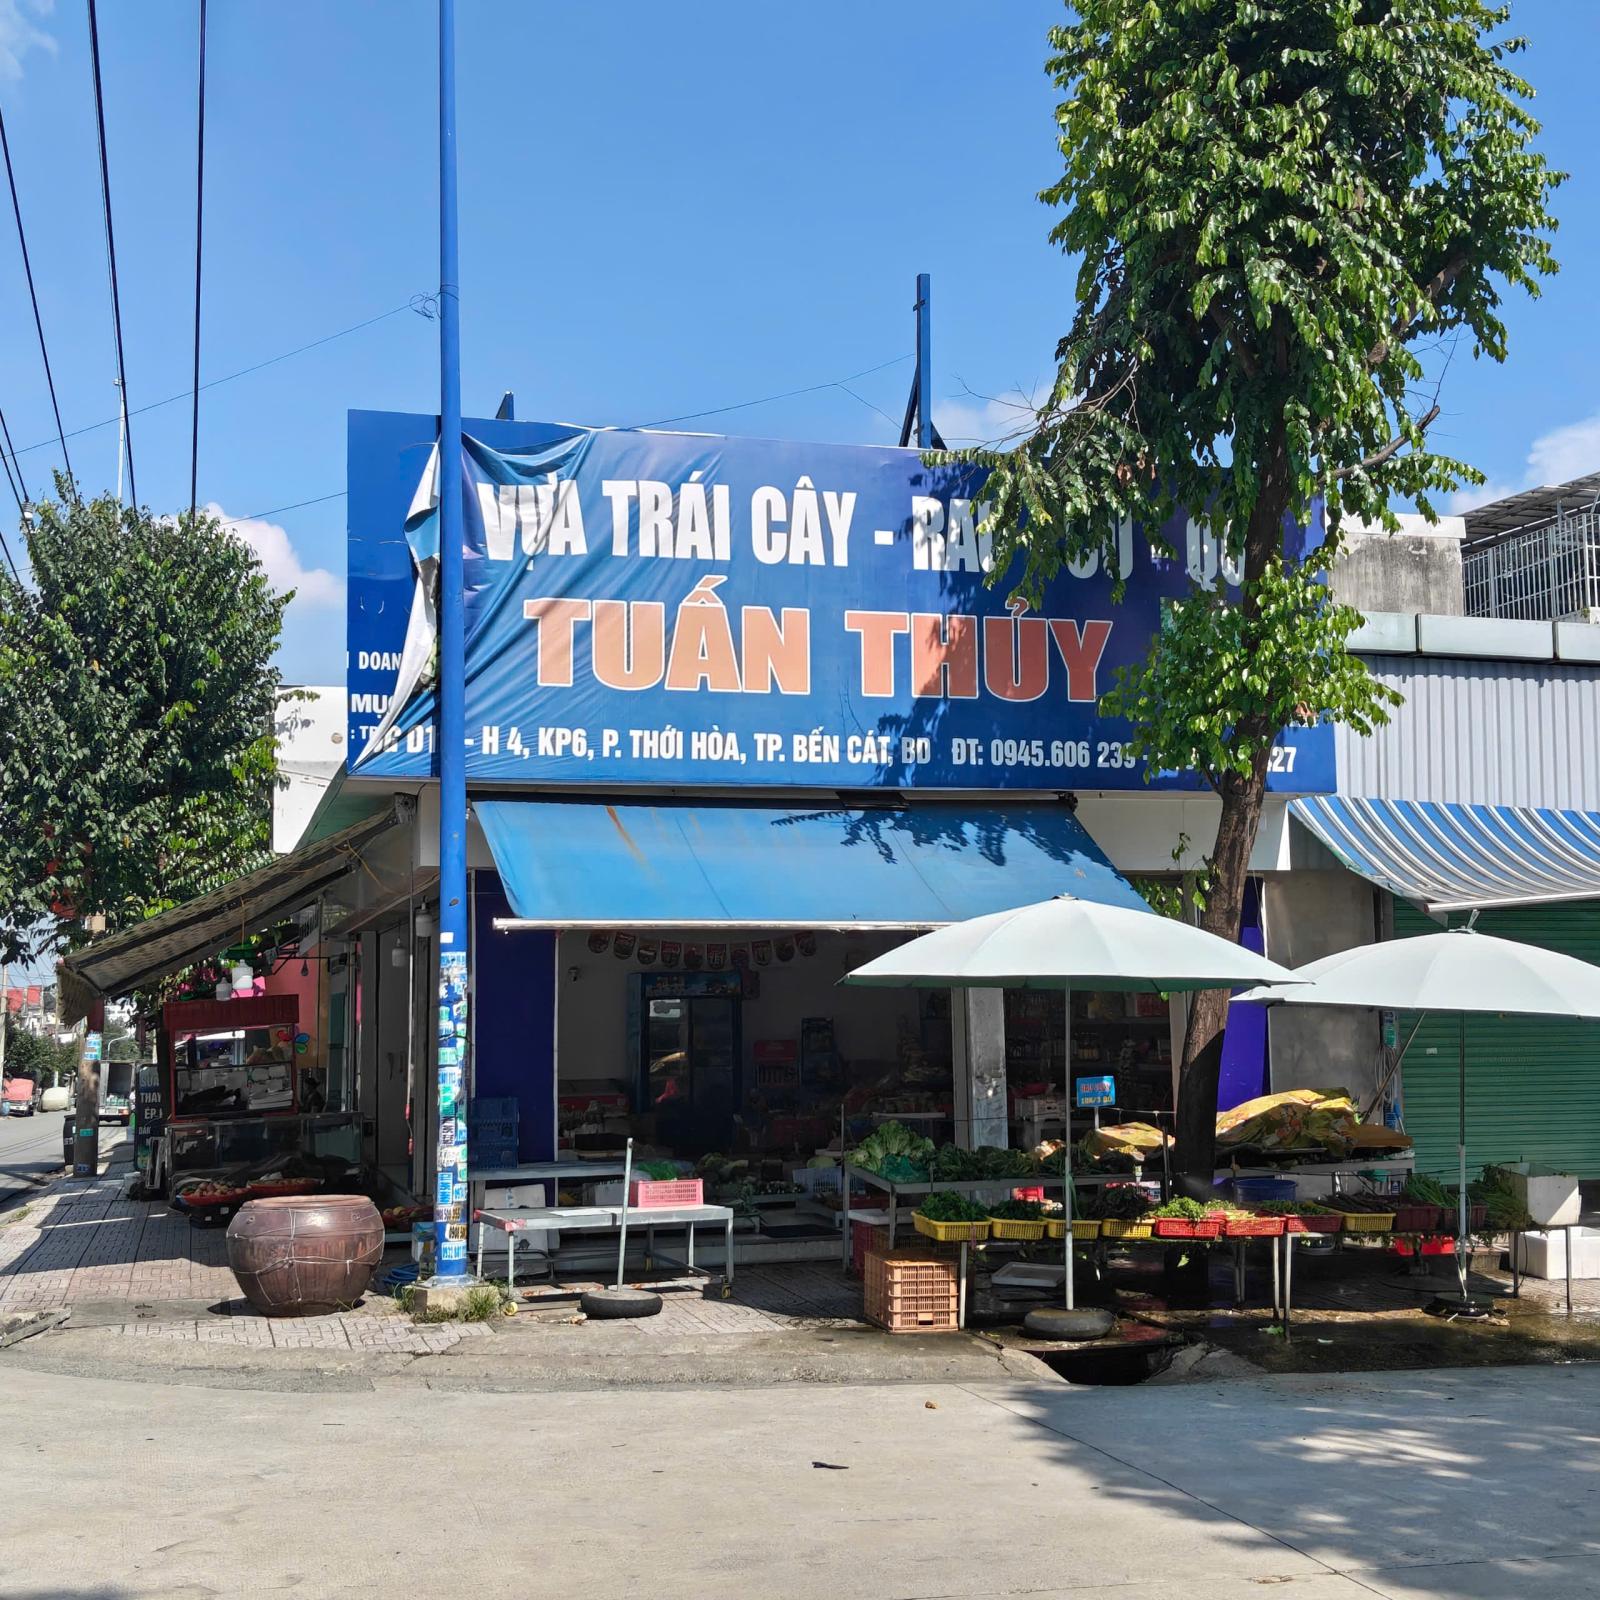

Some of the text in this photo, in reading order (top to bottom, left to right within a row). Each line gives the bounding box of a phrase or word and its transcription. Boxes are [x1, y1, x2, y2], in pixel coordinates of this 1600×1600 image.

[602, 470, 731, 560] TRÁI
[750, 475, 858, 567] CÂY
[873, 529, 894, 546] -
[523, 574, 1114, 703] TUẤN THỦY
[481, 725, 500, 755] H
[506, 727, 530, 760] 4,
[537, 726, 595, 761] KP6,
[602, 728, 622, 758] P.
[629, 724, 684, 760] THỚI
[691, 724, 747, 765] HÒA,
[753, 732, 786, 762] TP.
[792, 725, 841, 763] BẾN
[847, 729, 894, 767] CÁT,
[951, 737, 984, 766] ĐT:
[990, 738, 1090, 768] 0945.606
